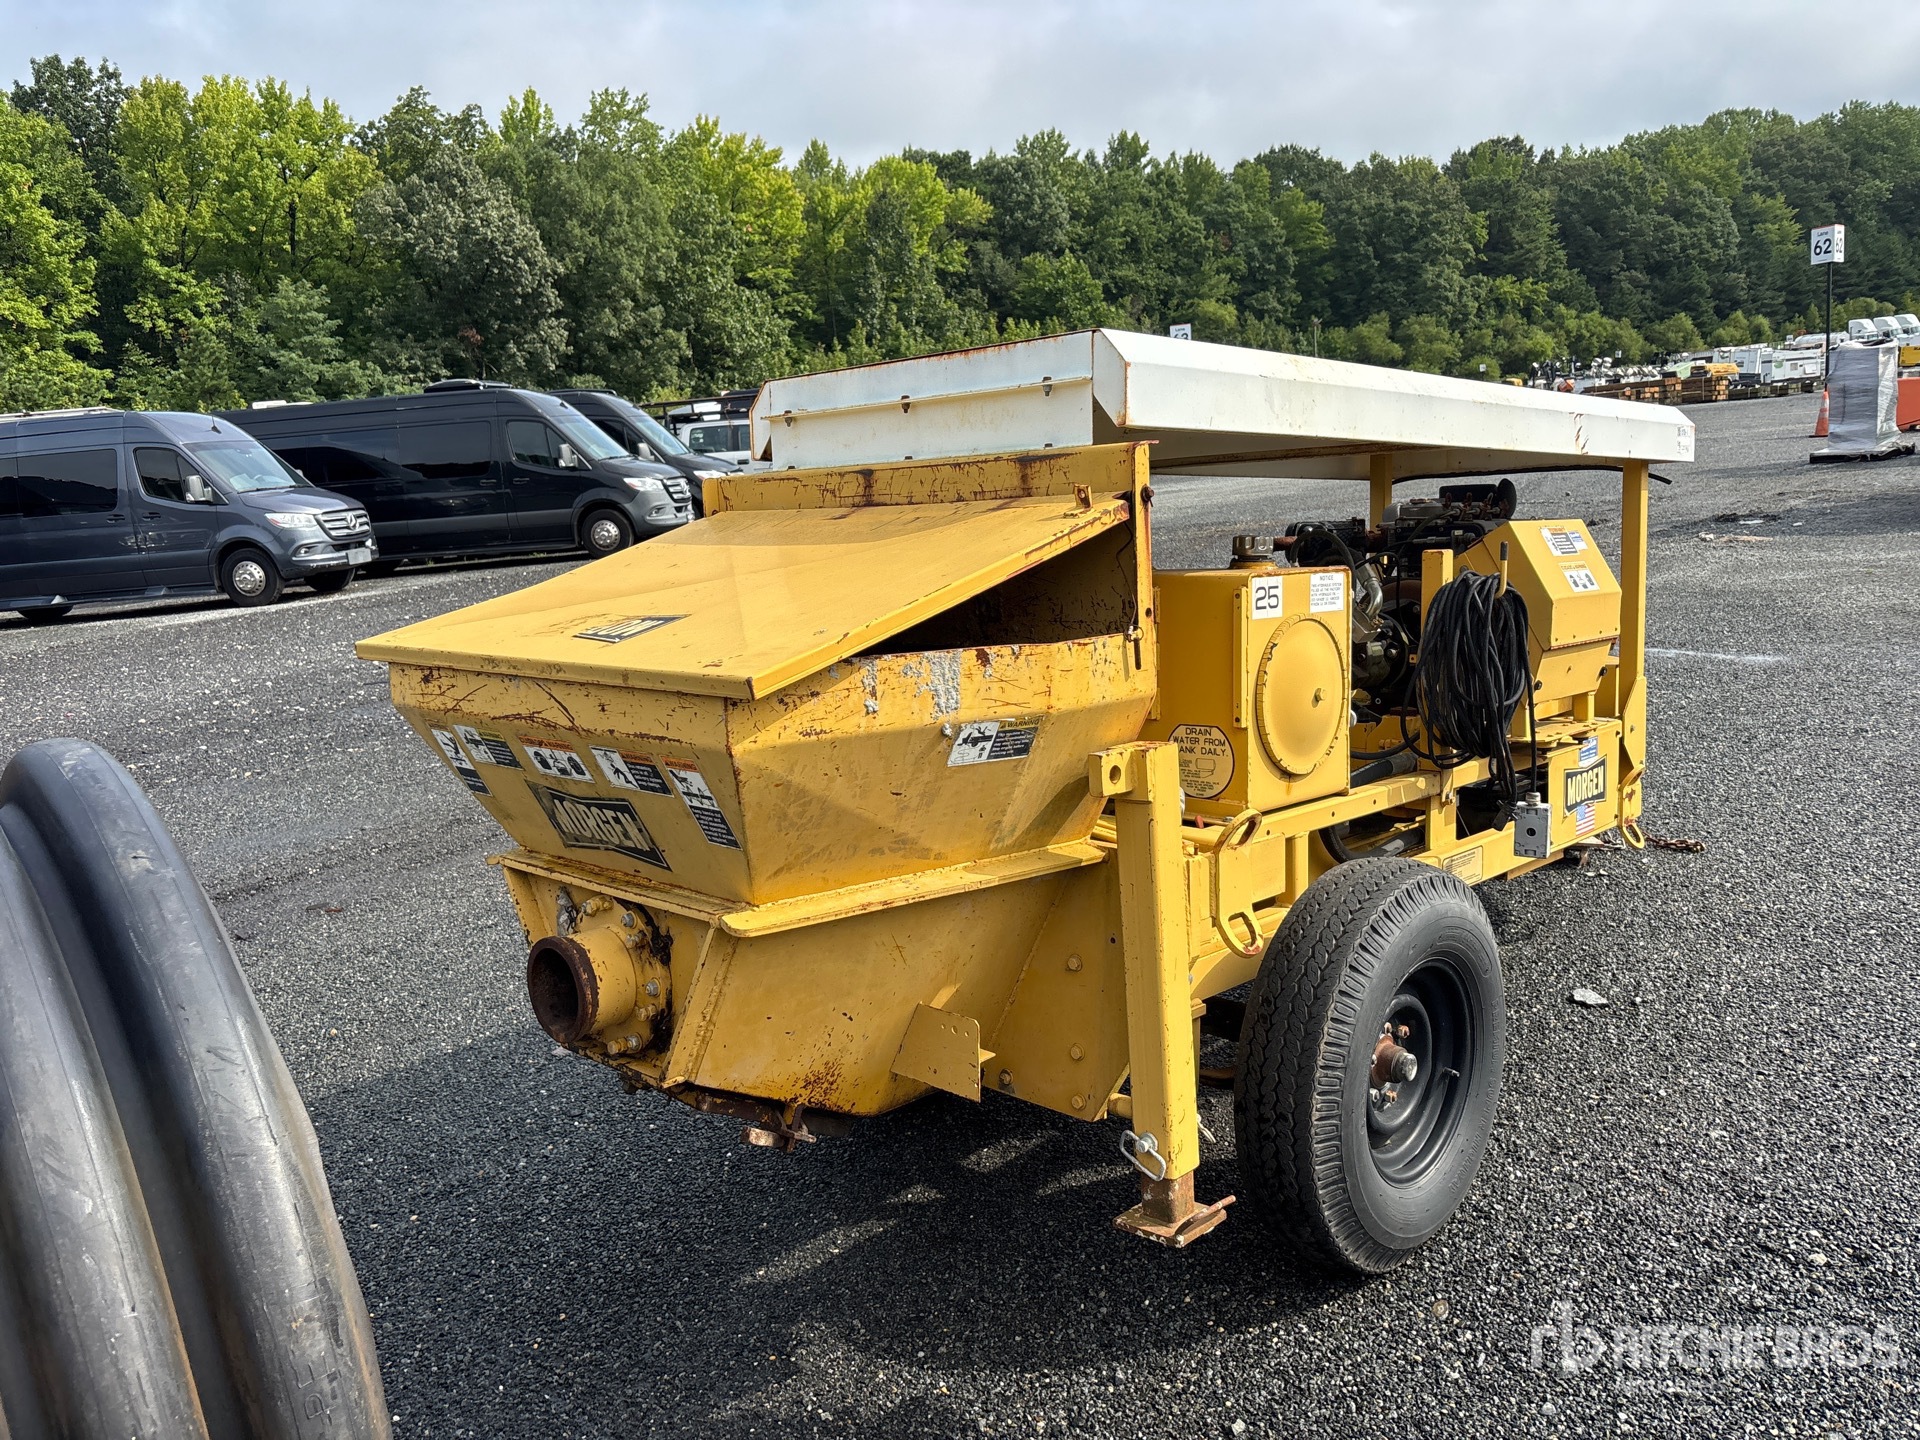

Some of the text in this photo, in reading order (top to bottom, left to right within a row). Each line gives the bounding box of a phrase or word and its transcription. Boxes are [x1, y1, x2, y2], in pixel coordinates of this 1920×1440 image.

[1813, 238, 1832, 256] 62
[1255, 585, 1279, 610] 25
[1008, 720, 1040, 728] WARNING
[1185, 727, 1212, 736] DRAIN
[1173, 736, 1226, 747] WATER FROM
[1179, 747, 1229, 757] ANK DAILY.
[1567, 765, 1604, 806] MORGEN
[553, 799, 650, 851] MORGEN
